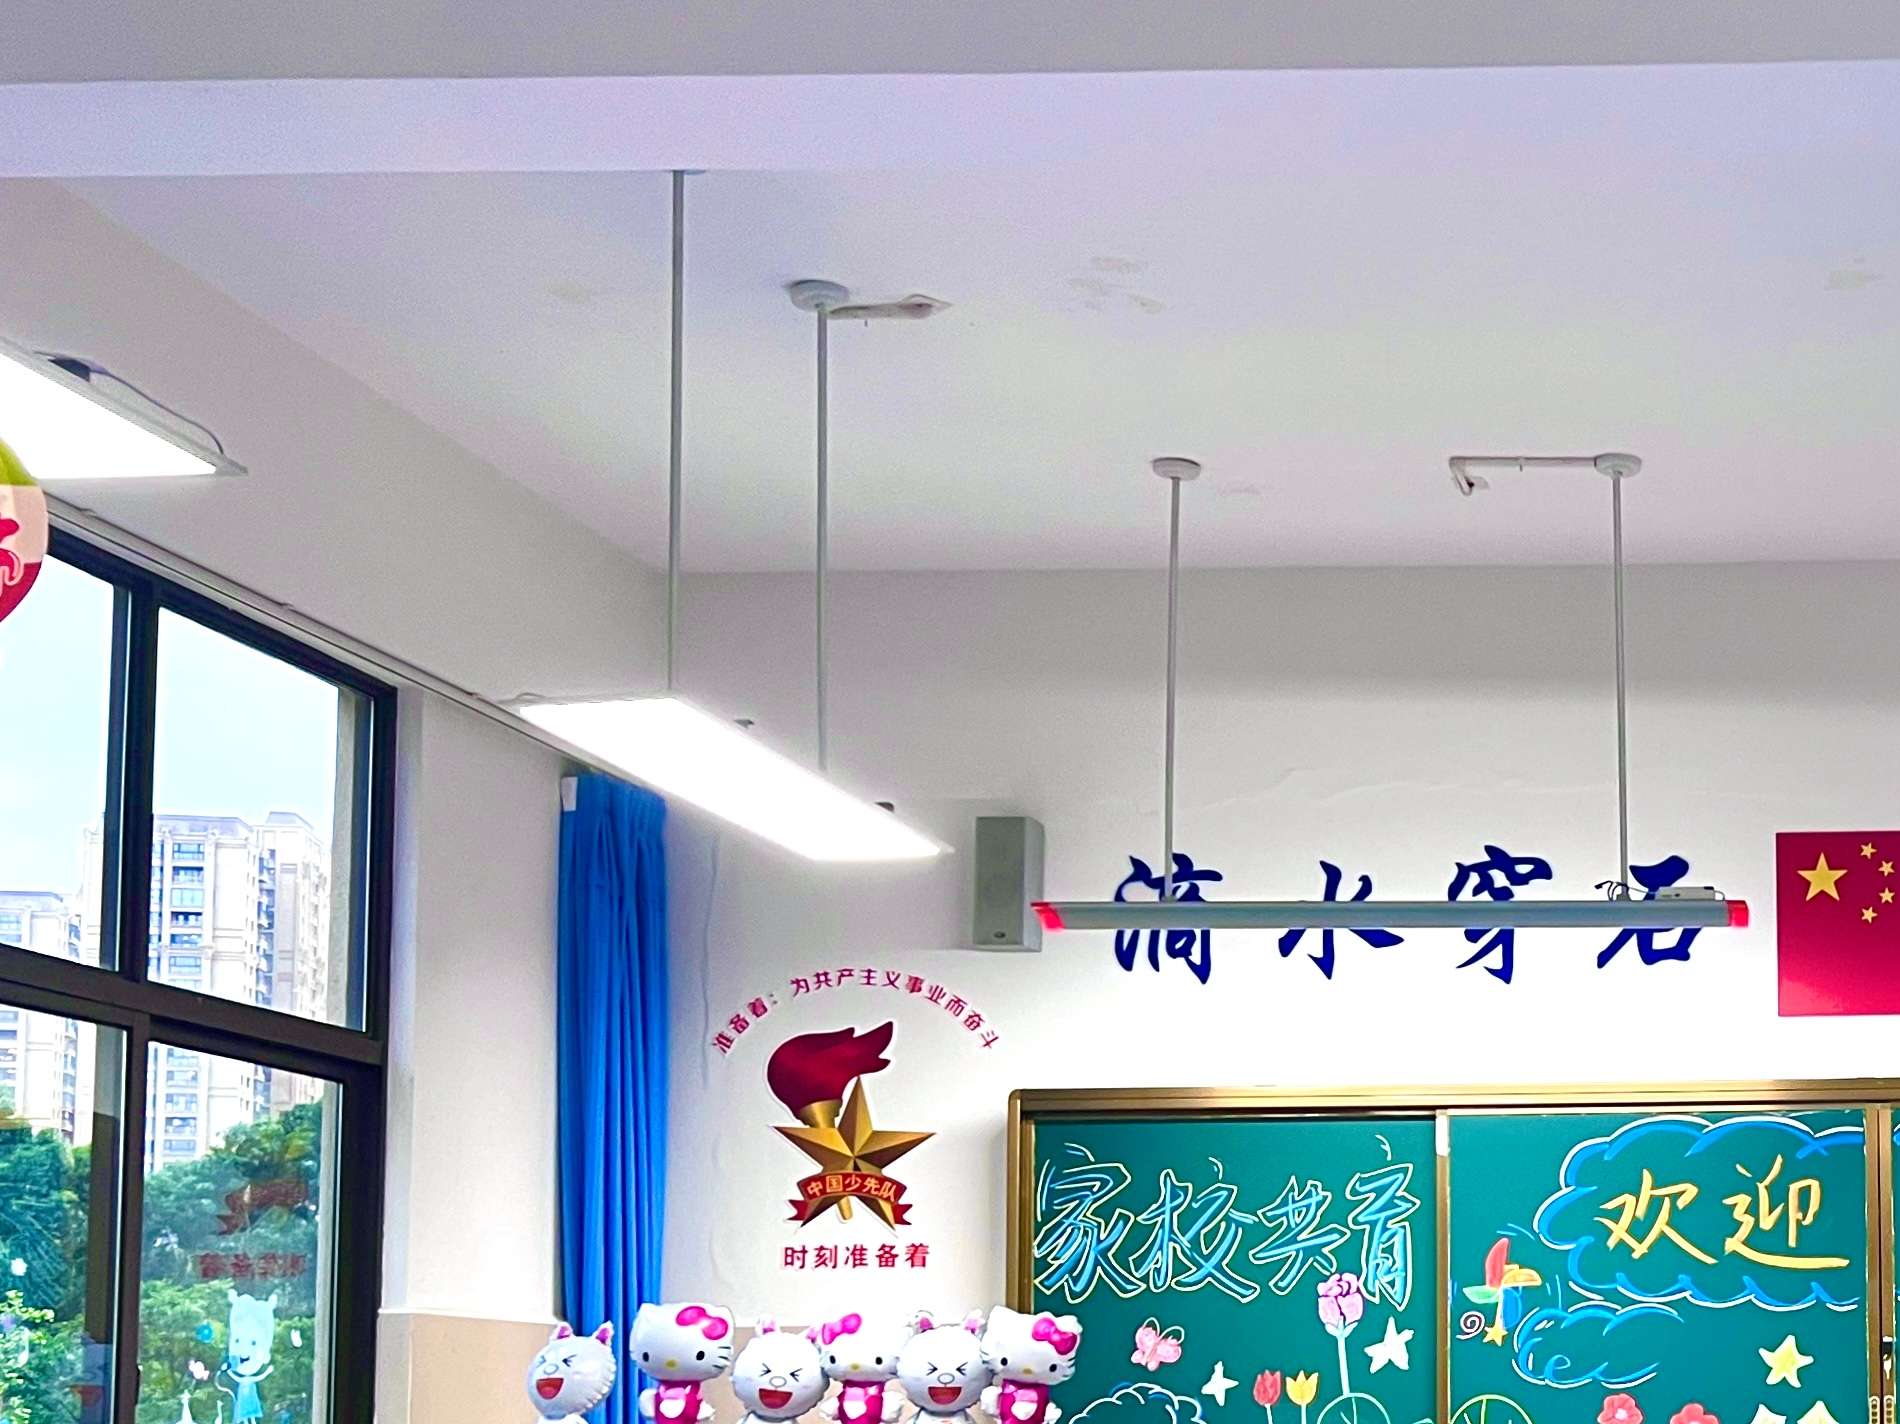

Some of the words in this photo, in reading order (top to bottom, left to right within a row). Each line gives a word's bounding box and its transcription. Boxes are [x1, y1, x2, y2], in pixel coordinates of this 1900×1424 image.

[1113, 845, 1703, 984] 滴水穿石
[807, 1174, 897, 1202] 中国少先队
[1034, 1136, 1420, 1305] 家校共育
[1598, 1154, 1850, 1270] 欢迎
[784, 1243, 930, 1269] 时刻准备着
